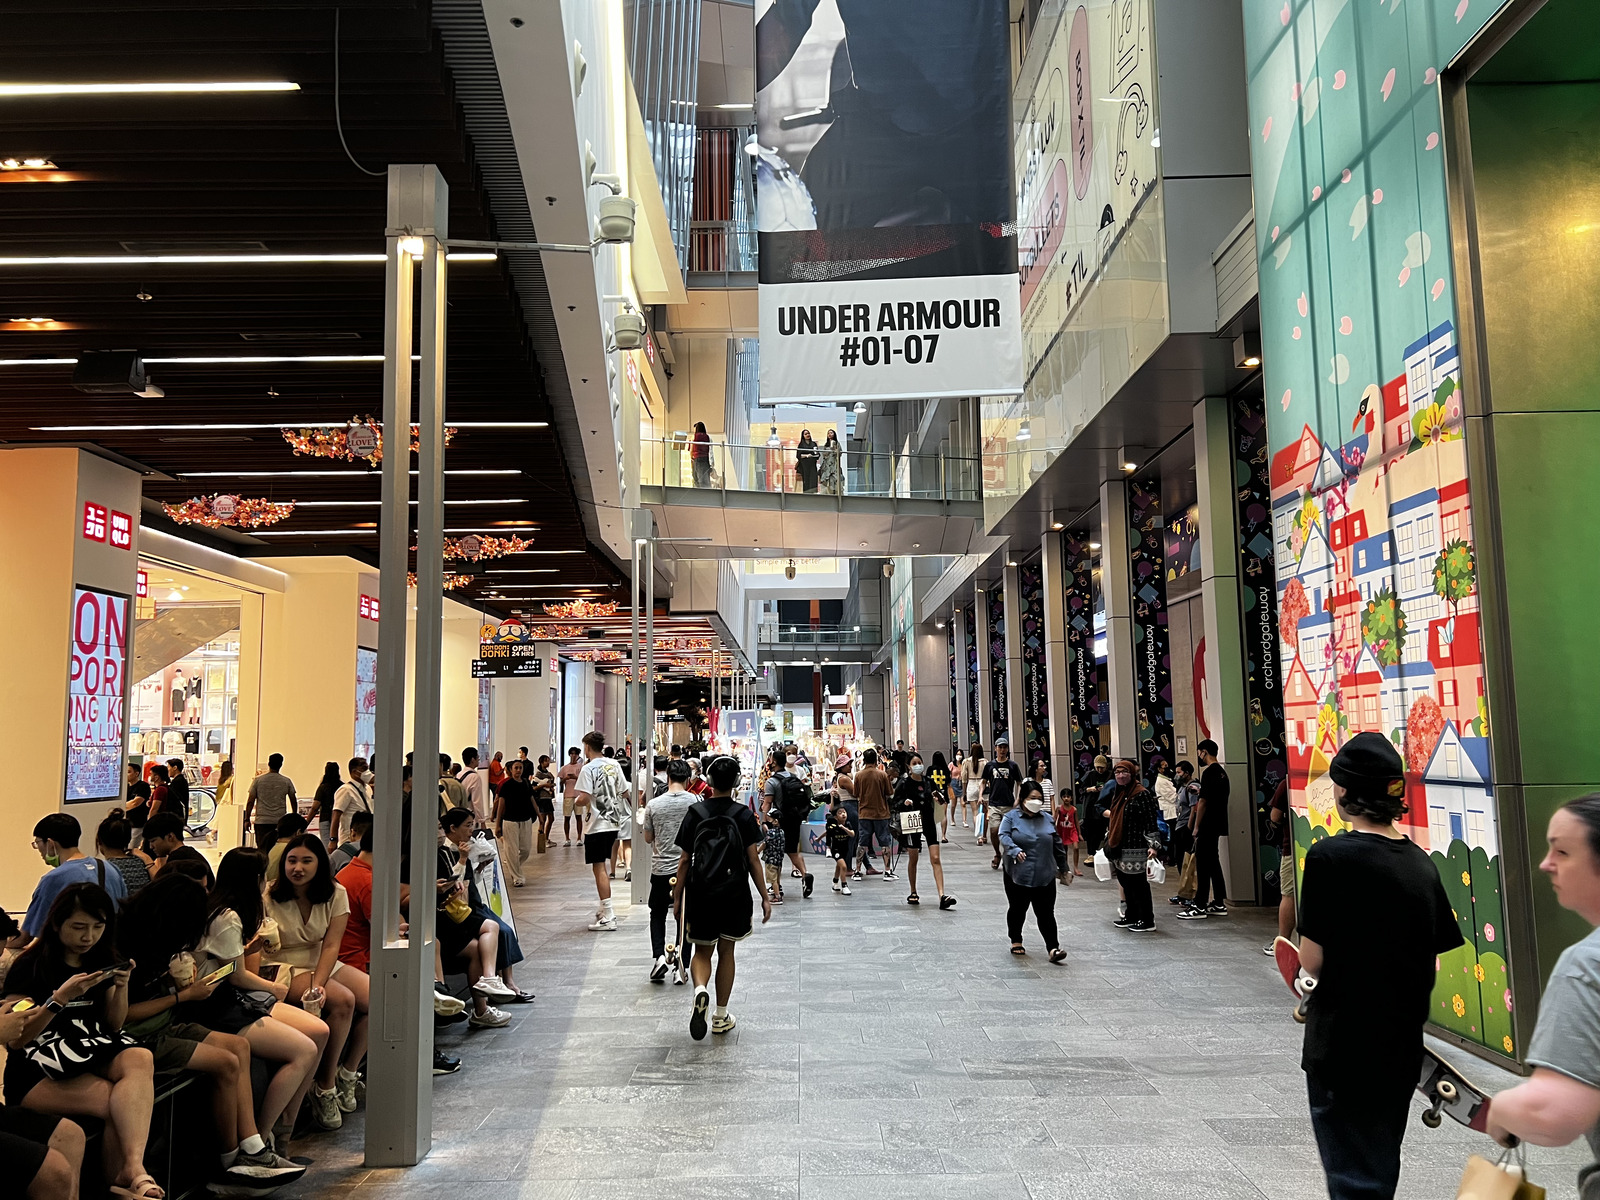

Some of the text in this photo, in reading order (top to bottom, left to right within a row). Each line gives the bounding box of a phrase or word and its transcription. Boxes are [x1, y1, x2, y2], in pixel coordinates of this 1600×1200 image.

[1040, 100, 1056, 155] LUV
[778, 303, 871, 337] UNDER
[876, 298, 1001, 332] ARMOUR
[839, 334, 940, 368] #01-07
[351, 439, 373, 447] LOVE
[111, 529, 129, 545] QLO
[112, 514, 129, 532] UNI
[74, 591, 128, 659] ON
[1259, 586, 1274, 690] orchardgateway
[71, 654, 126, 697] POR
[481, 650, 510, 658] DONKI
[1145, 624, 1157, 703] orchardgateway
[1031, 662, 1039, 716] orchardgateway
[1077, 647, 1086, 711] orchardgateway
